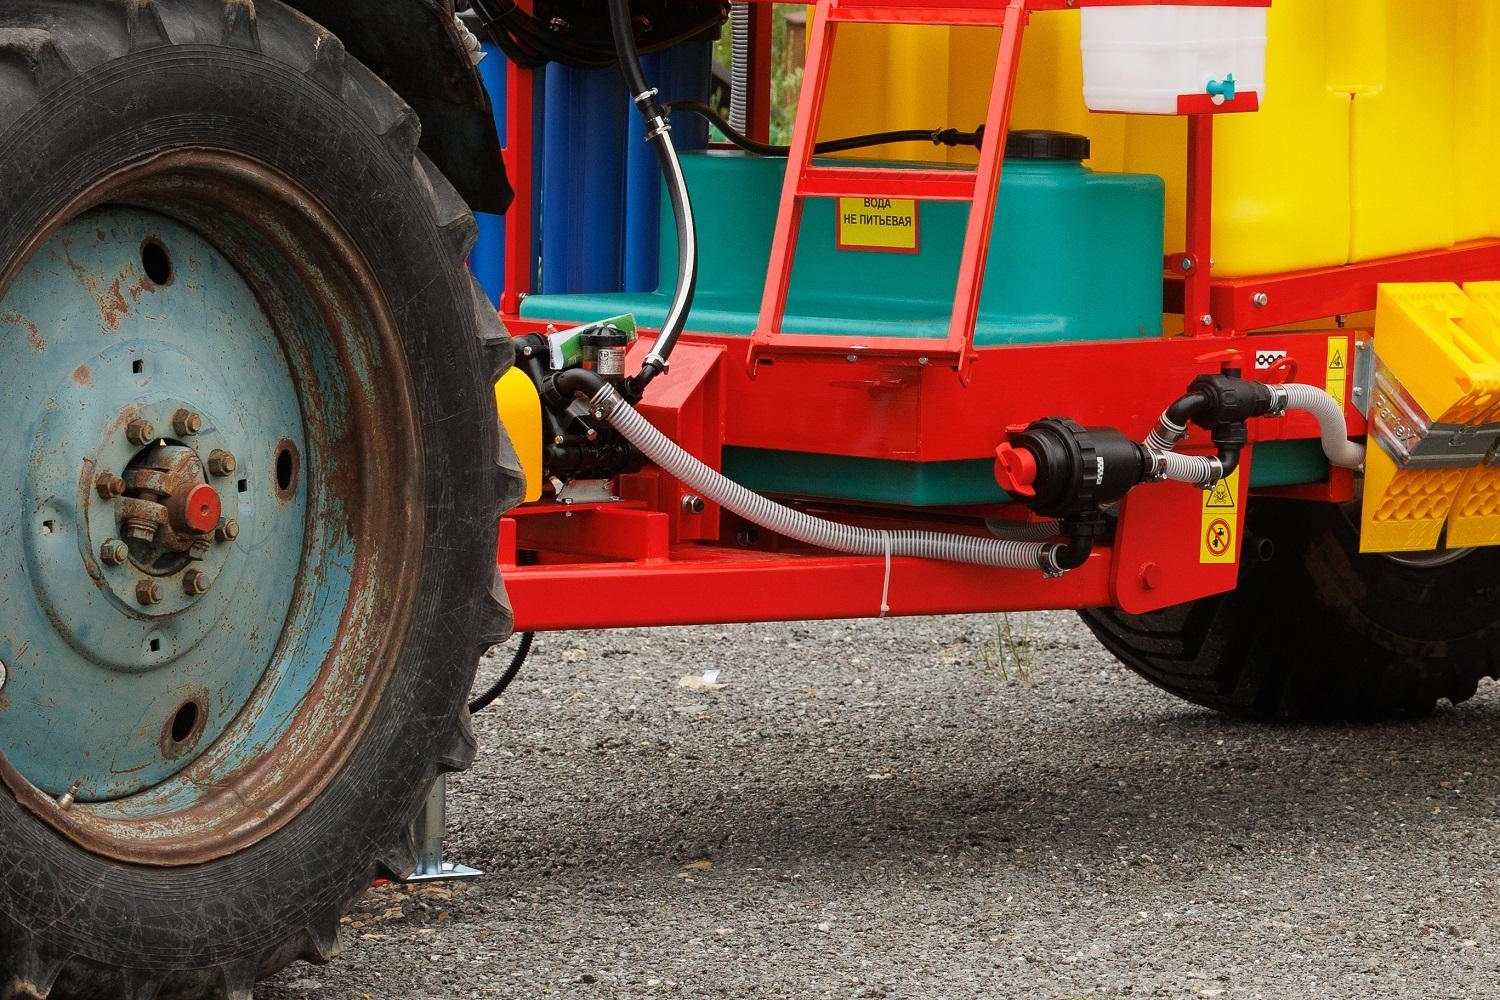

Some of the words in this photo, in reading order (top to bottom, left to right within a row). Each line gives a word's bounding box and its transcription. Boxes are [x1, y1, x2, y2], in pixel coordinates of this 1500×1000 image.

[863, 197, 892, 210] ВОДА
[843, 213, 857, 225] НЕ
[859, 214, 912, 227] ПИТЬЕВАЯ
